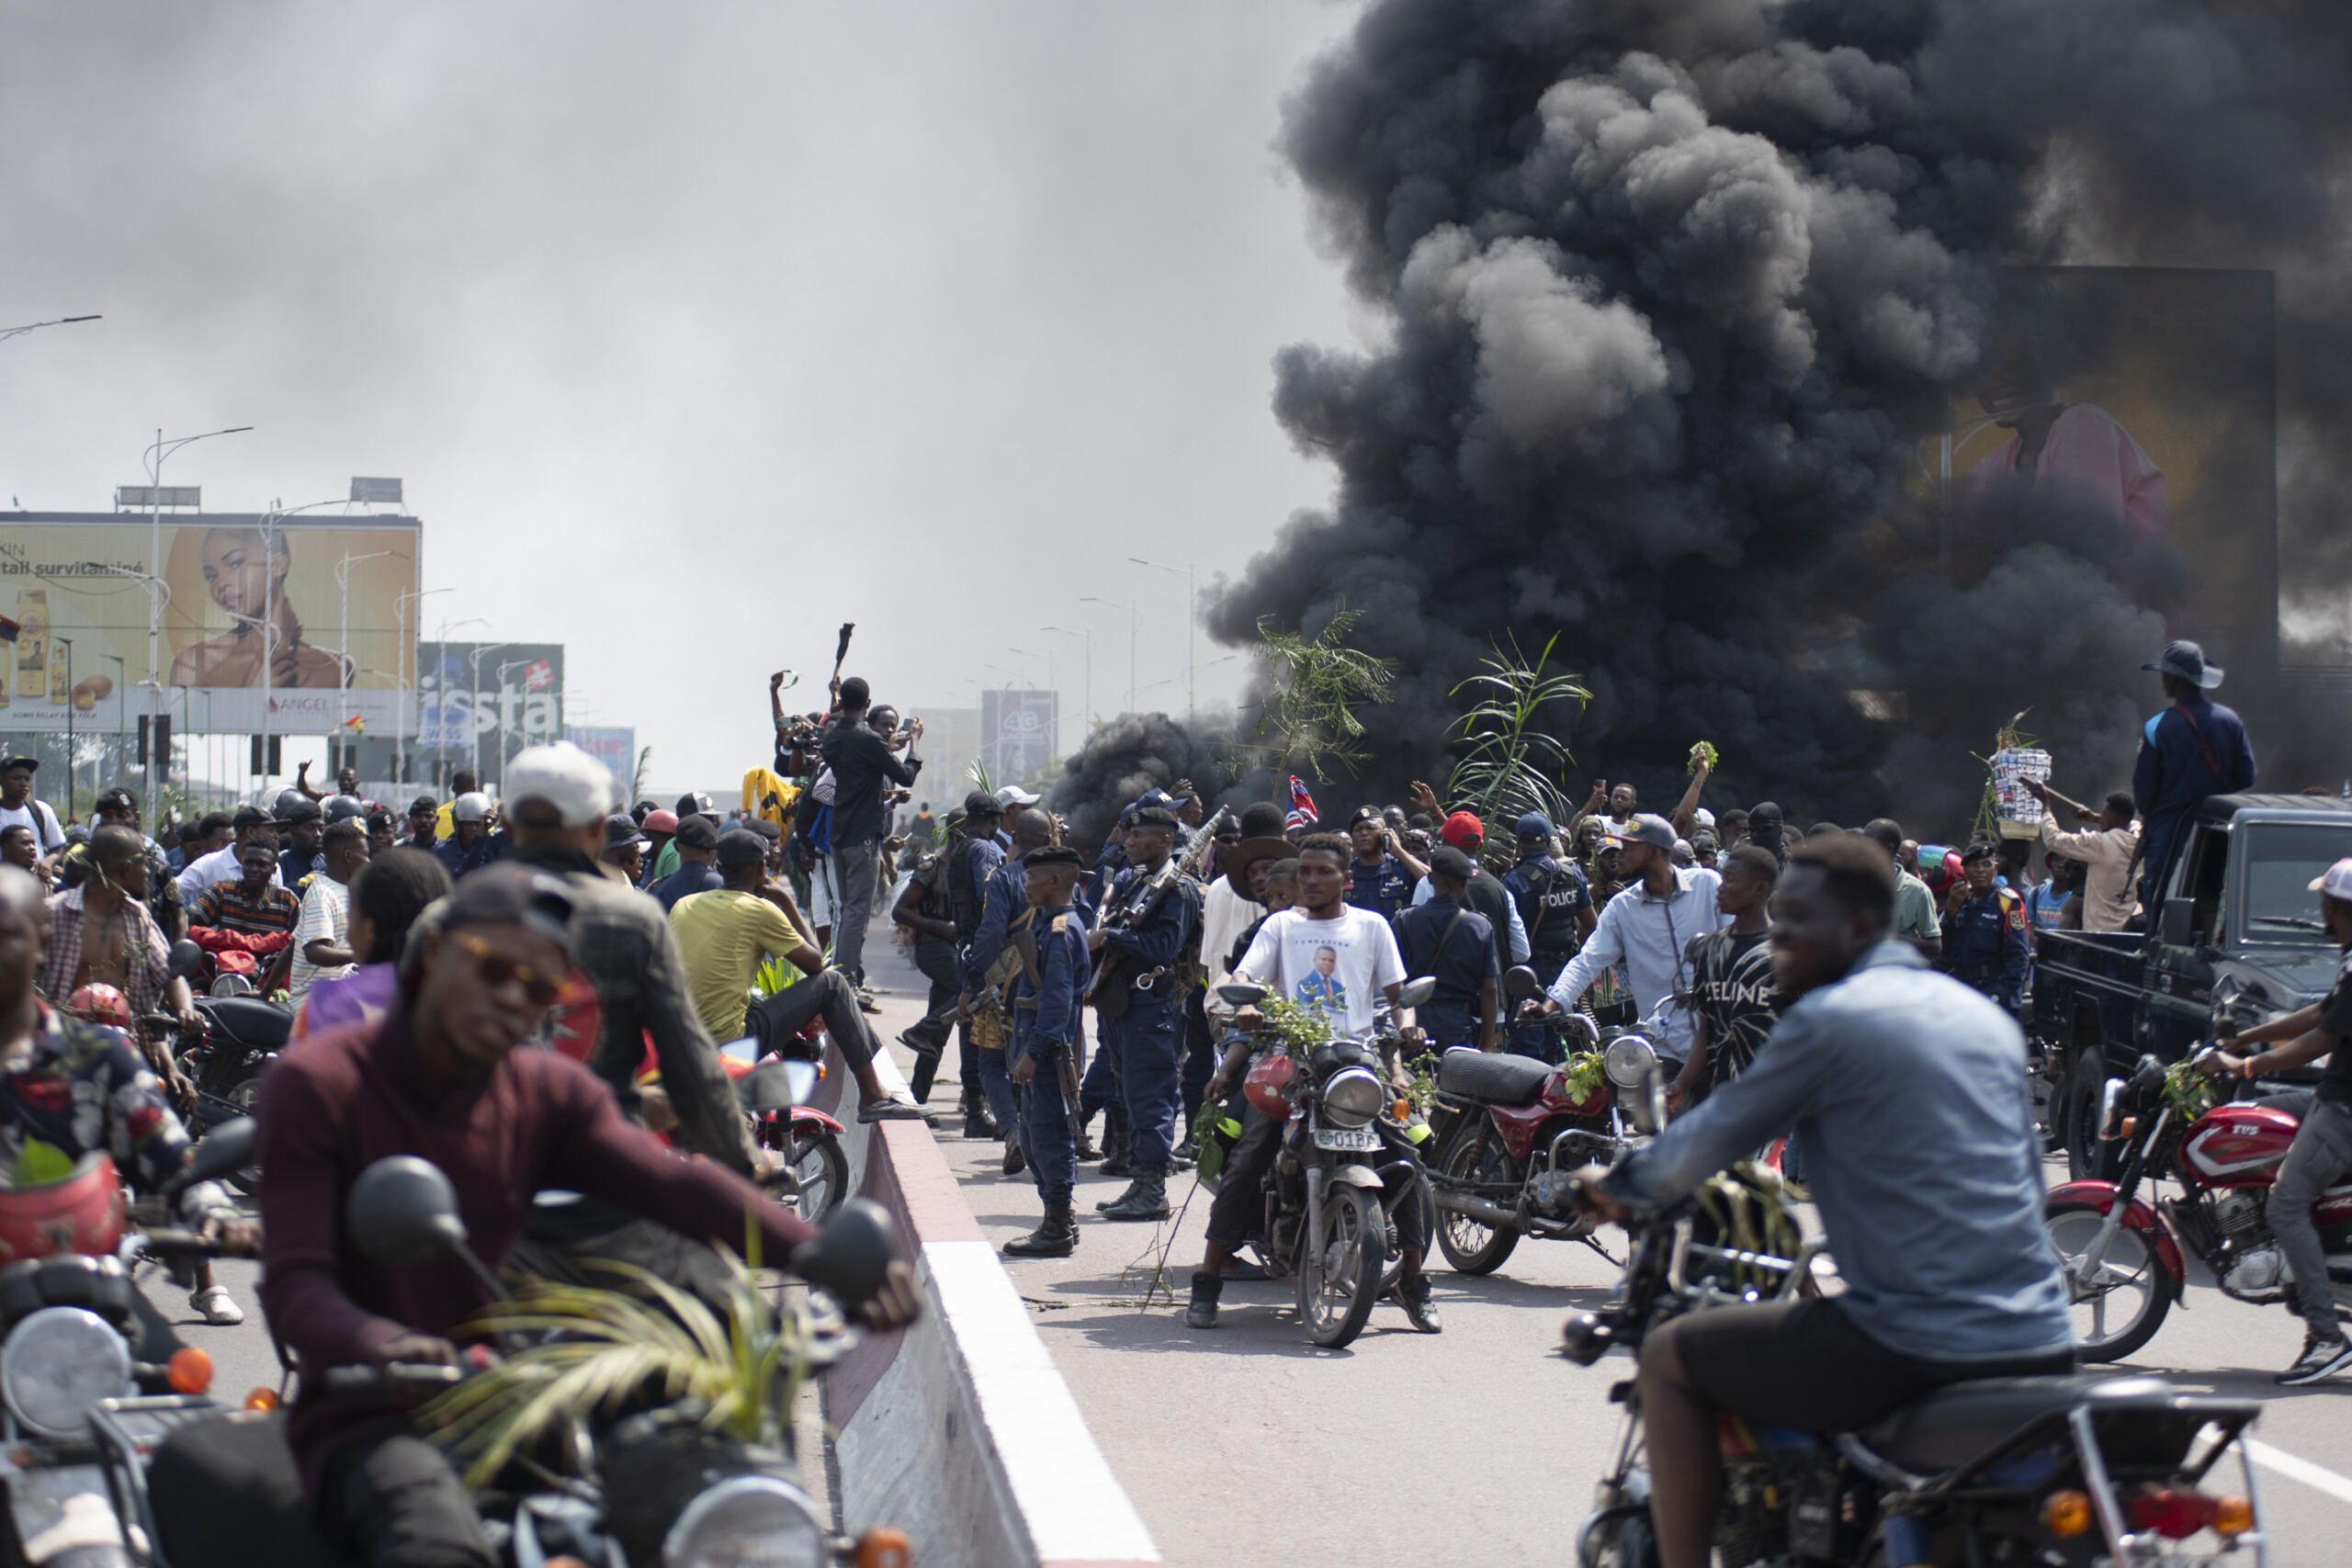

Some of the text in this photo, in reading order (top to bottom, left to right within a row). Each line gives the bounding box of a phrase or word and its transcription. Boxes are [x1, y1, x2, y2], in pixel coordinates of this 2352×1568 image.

[35, 560, 144, 576] survitaminé
[280, 697, 329, 711] ANGEL
[1003, 711, 1037, 731] 4G
[2232, 1124, 2259, 1135] TVS
